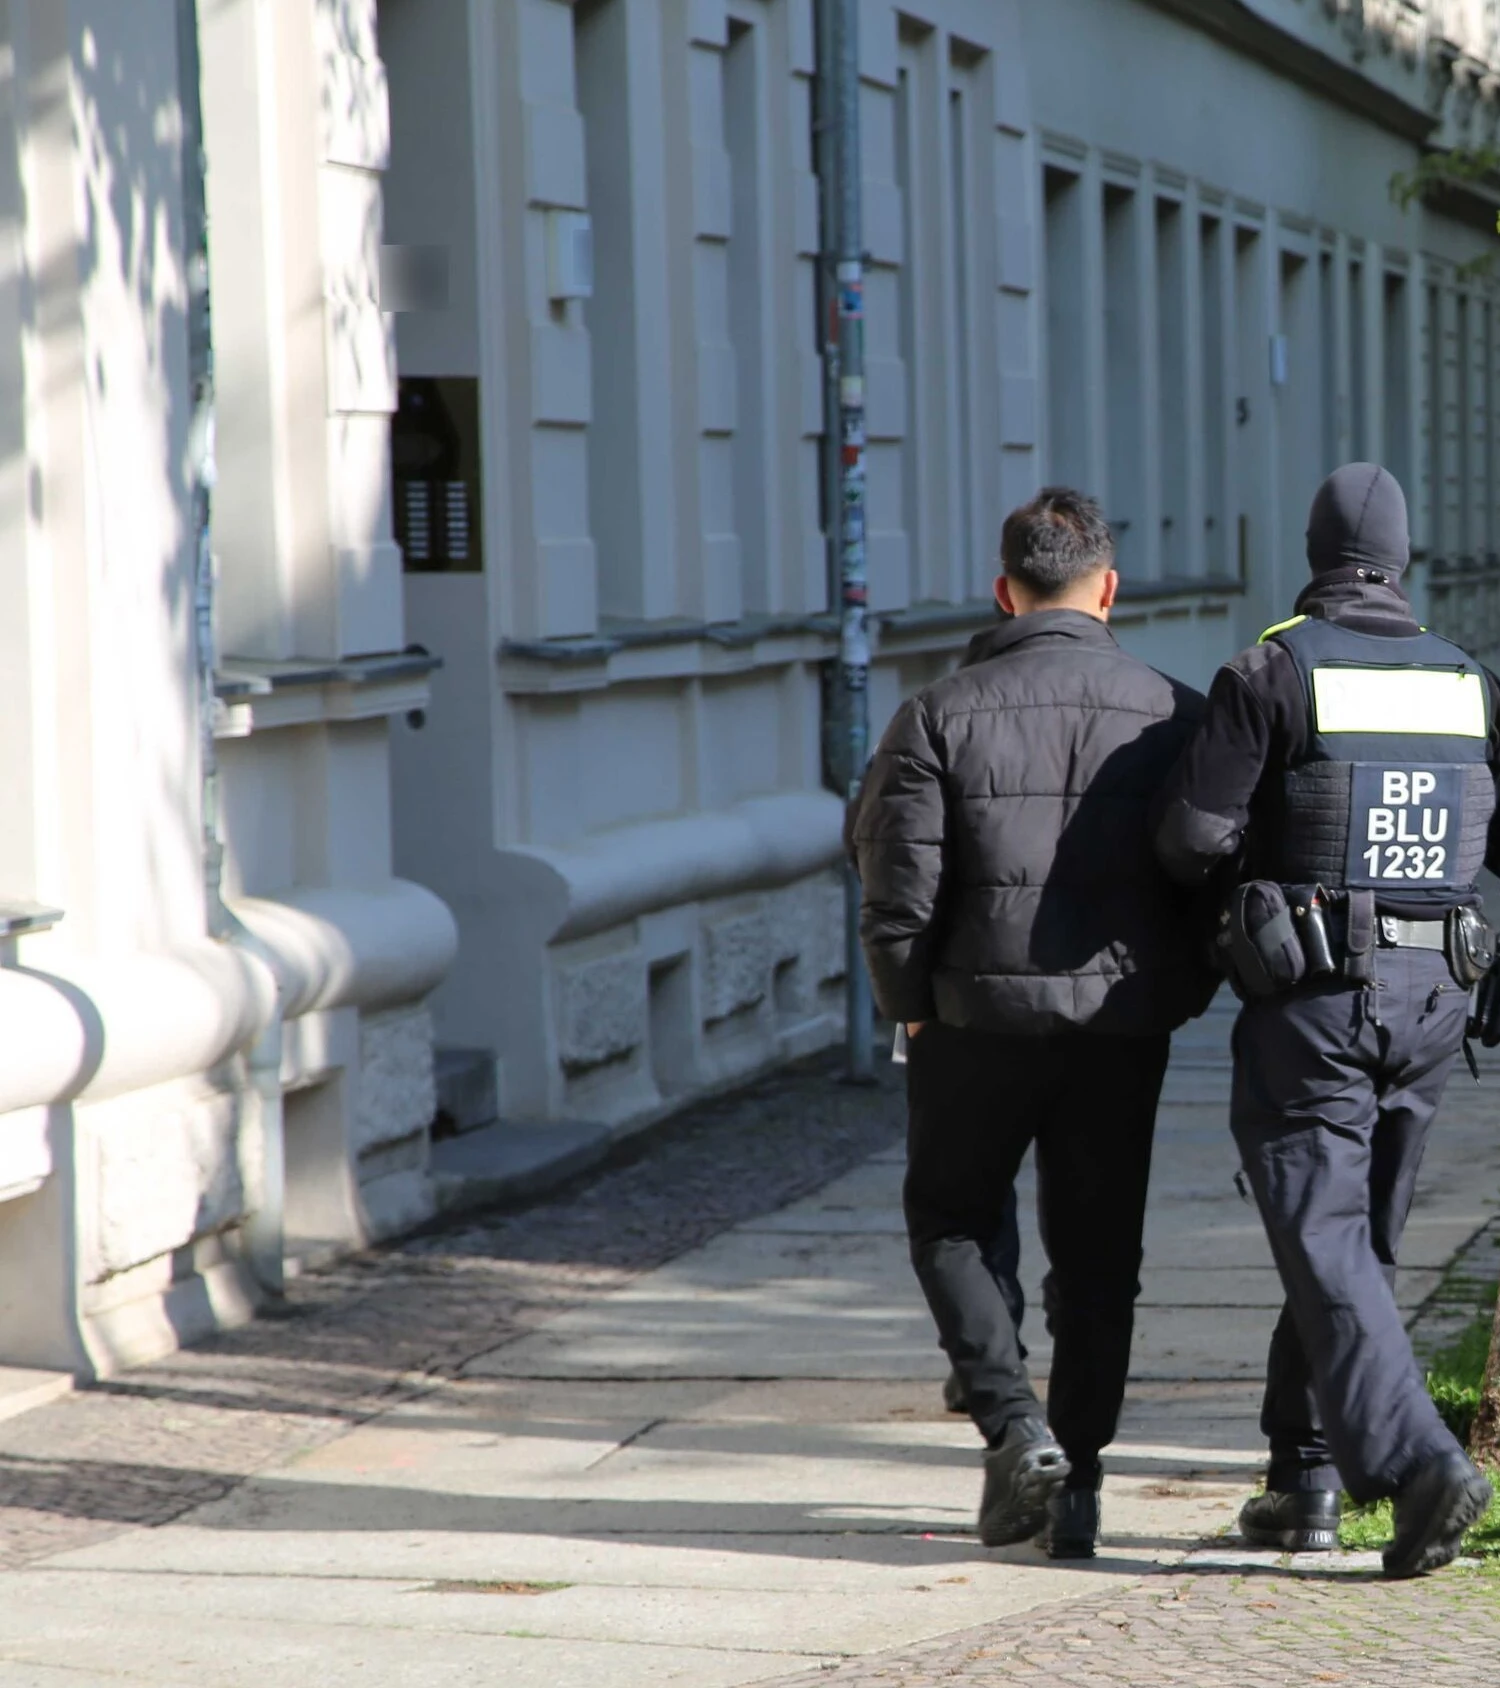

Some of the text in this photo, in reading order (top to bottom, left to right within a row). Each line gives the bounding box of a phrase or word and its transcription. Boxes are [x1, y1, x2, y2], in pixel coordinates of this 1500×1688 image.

[1382, 770, 1437, 806] BP
[1367, 807, 1448, 843] BLU
[1363, 844, 1446, 879] 1232
